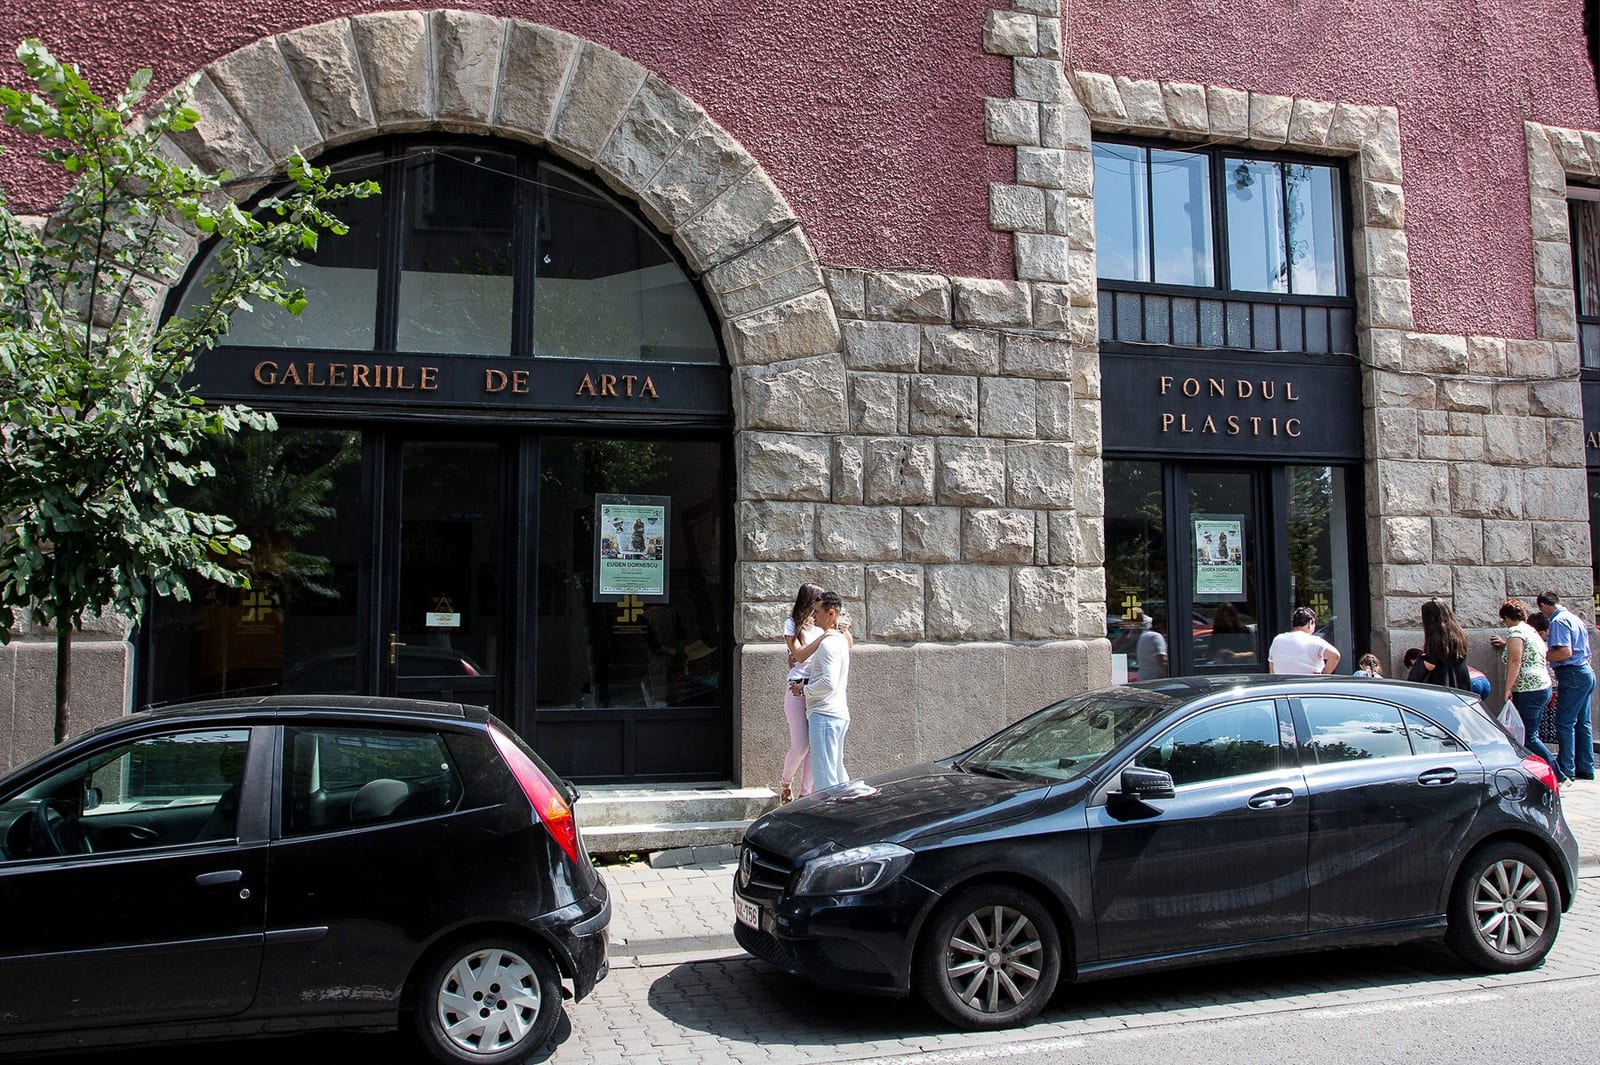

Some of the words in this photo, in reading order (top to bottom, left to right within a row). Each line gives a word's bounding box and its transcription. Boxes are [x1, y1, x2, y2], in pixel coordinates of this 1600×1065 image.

[253, 361, 439, 390] GALERIILE
[485, 369, 530, 394] DE
[576, 373, 660, 399] ARTA
[1160, 376, 1300, 401] FONDUL
[1162, 413, 1301, 438] PLASTIC
[1586, 431, 1600, 448] A
